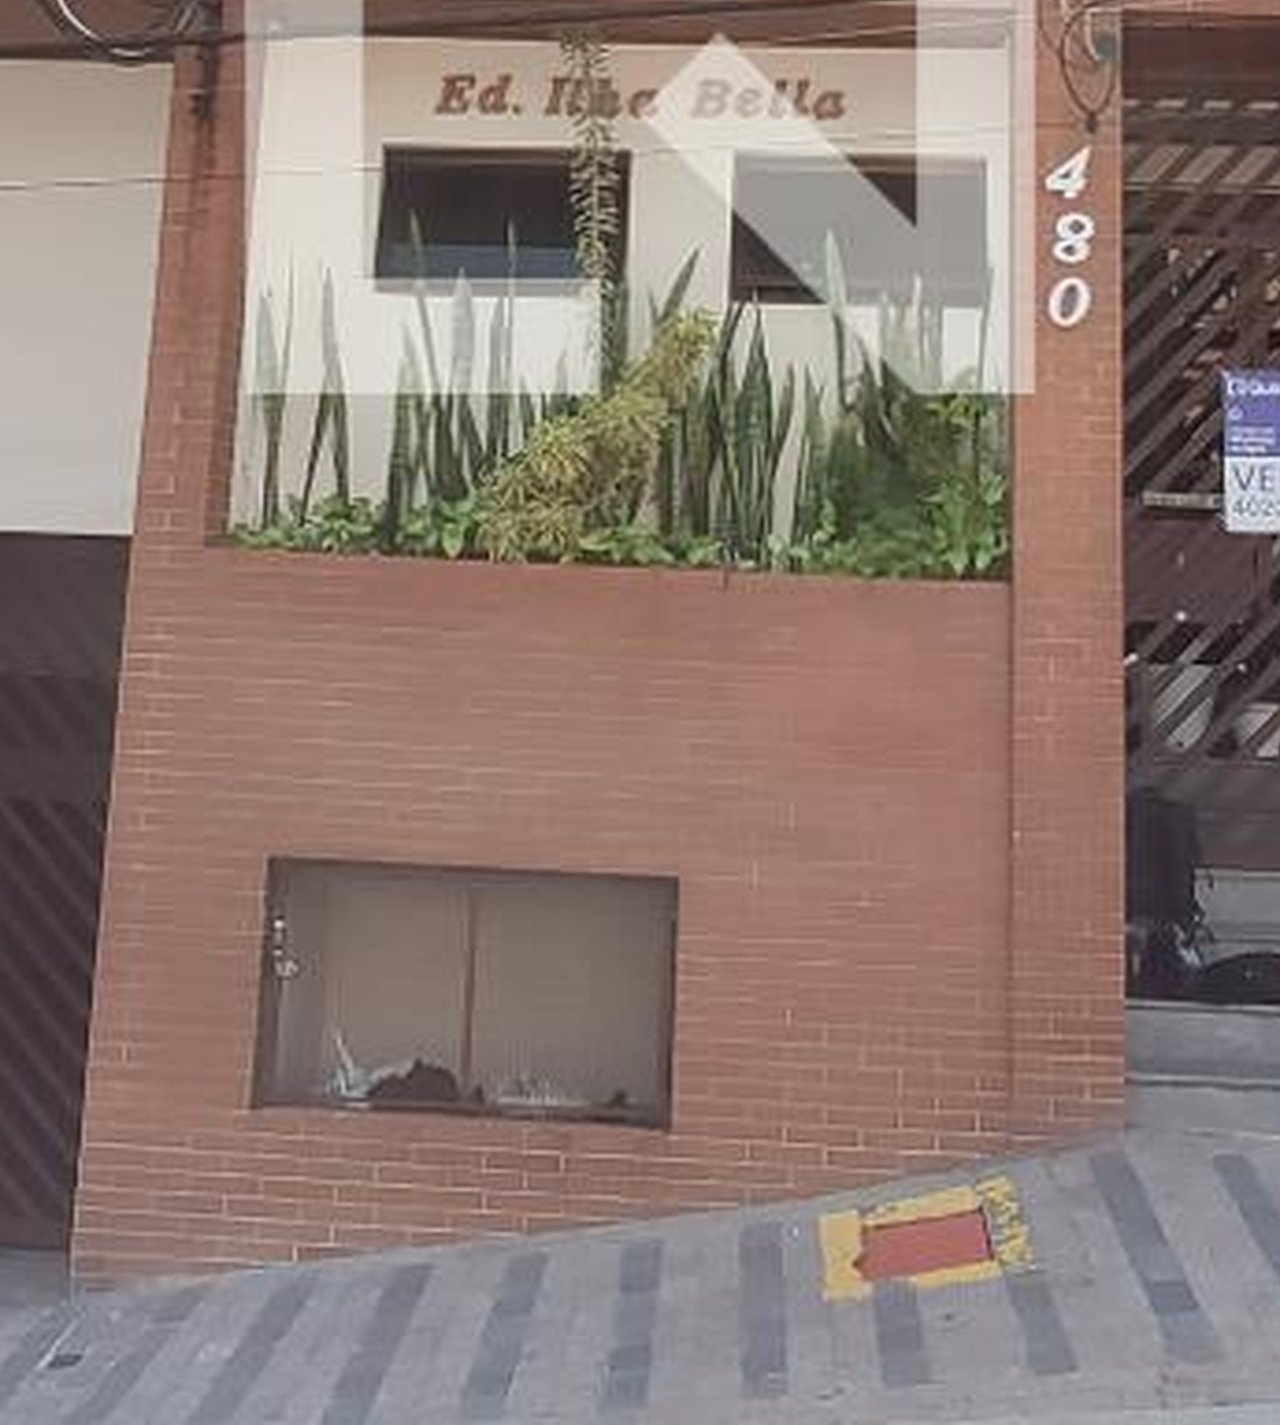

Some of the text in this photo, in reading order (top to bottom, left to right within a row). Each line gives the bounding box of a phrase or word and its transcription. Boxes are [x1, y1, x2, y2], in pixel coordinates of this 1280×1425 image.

[434, 75, 522, 117] Ed.
[690, 77, 847, 120] Bella
[1045, 144, 1095, 328] 480
